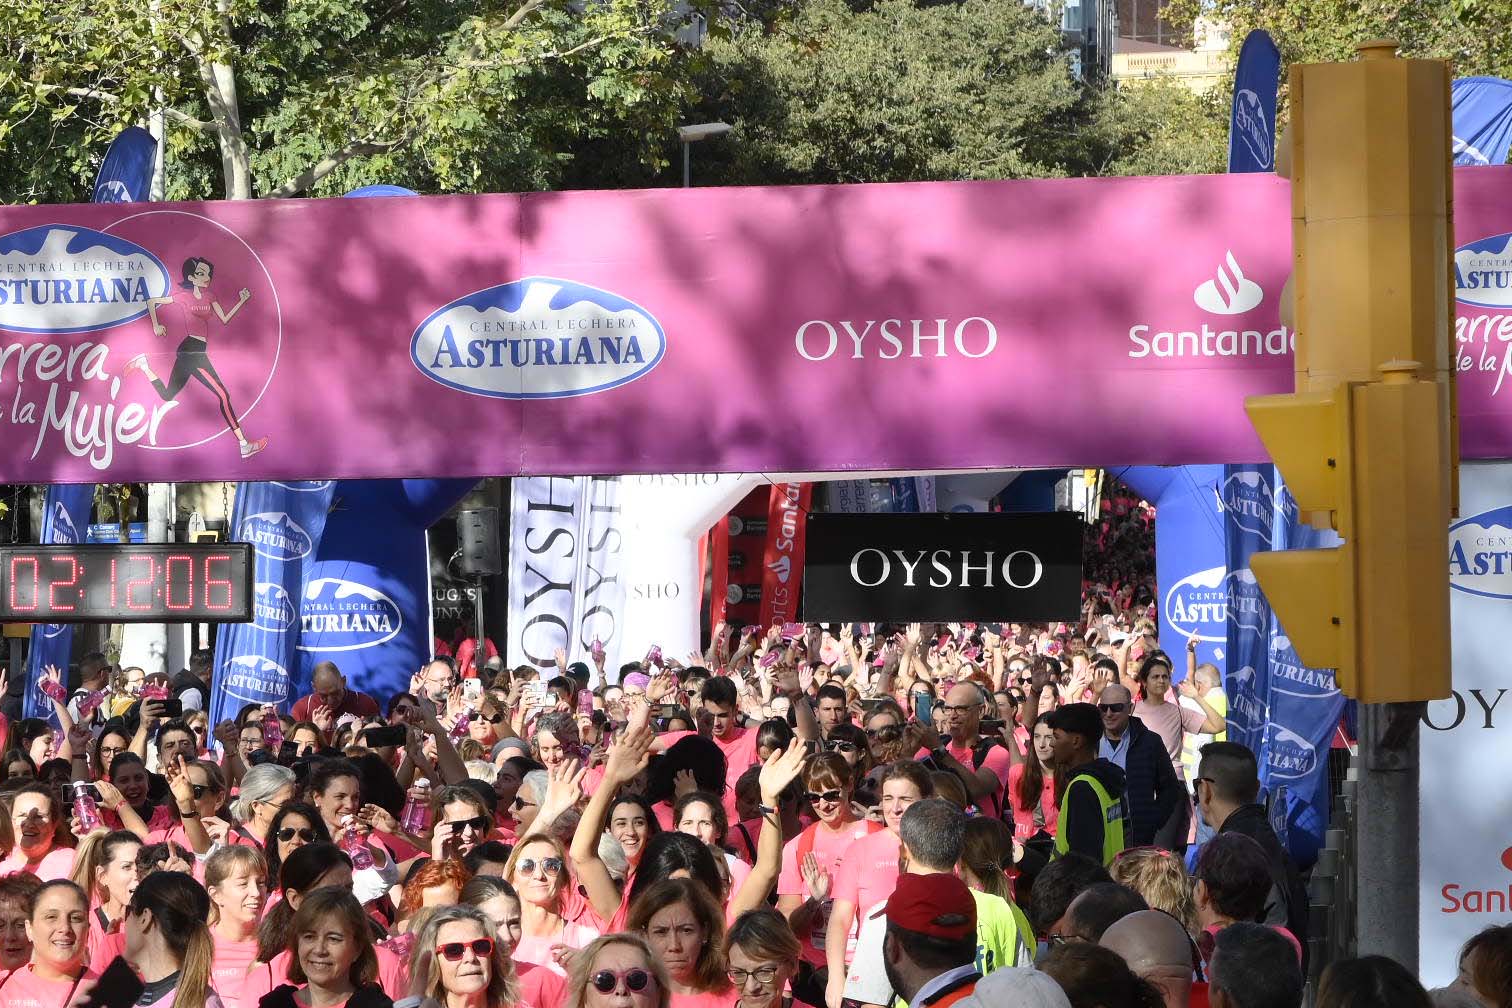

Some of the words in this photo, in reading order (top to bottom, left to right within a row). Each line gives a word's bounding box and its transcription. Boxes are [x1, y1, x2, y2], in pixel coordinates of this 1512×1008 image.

[73, 259, 146, 273] LECHERA
[469, 319, 549, 334] CENTRAL
[556, 317, 638, 332] LECHERA
[795, 316, 998, 361] OYSHO
[430, 325, 646, 369] ASTURIANA
[1479, 345, 1497, 371] la
[11, 386, 36, 425] la
[30, 378, 180, 470] Mujer
[851, 547, 1044, 589] OYSHO
[1449, 540, 1512, 576] AST
[10, 555, 232, 611] 02:12:06
[339, 602, 388, 611] LECHERA
